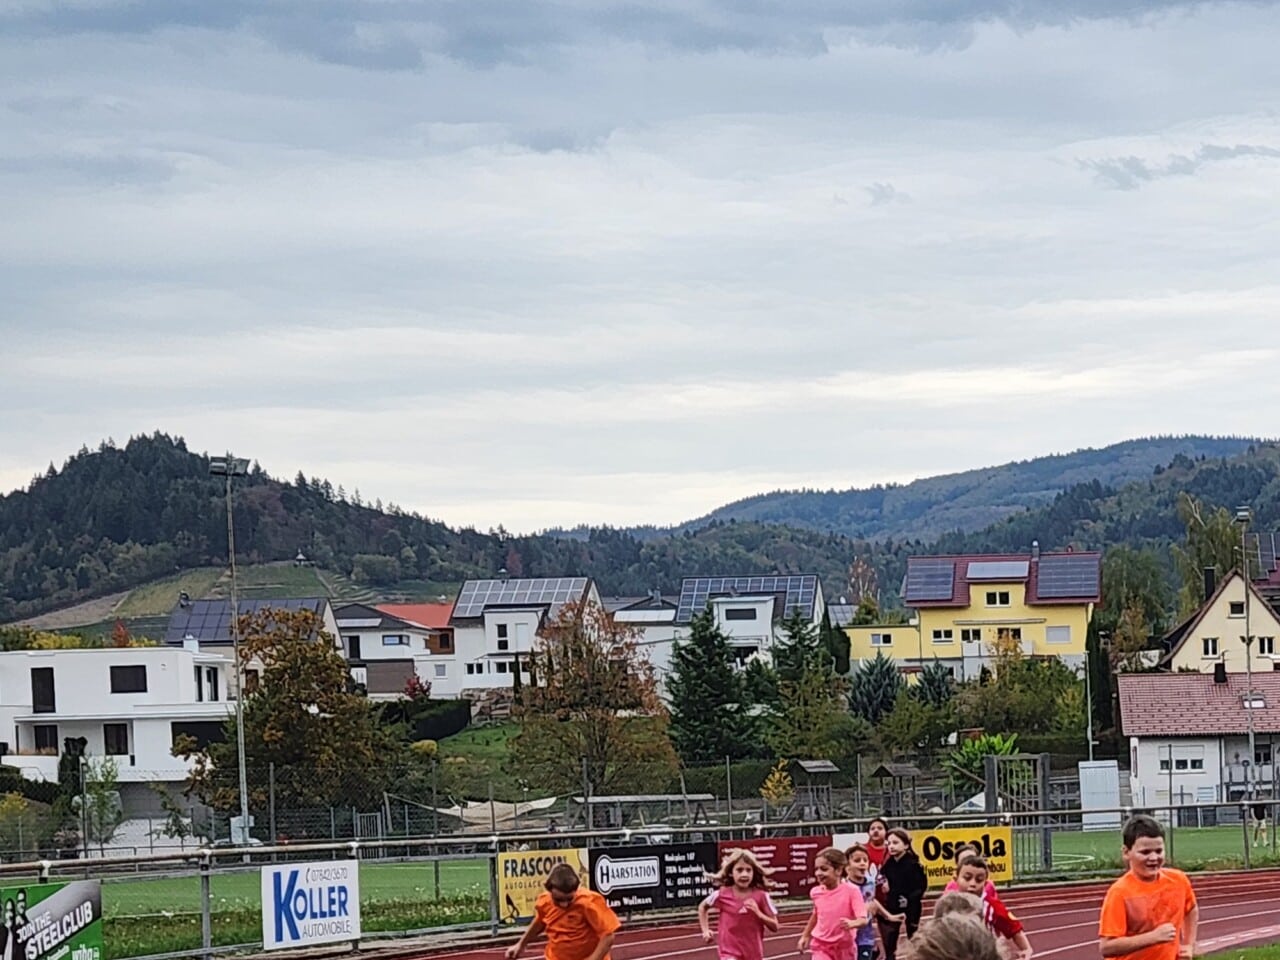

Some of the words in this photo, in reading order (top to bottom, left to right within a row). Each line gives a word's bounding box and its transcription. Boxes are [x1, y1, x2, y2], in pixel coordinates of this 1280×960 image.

[923, 834, 1006, 861] Osola
[600, 865, 656, 884] HAARSTATION
[273, 870, 349, 942] KOLLER
[16, 920, 35, 943] JOIN
[35, 911, 52, 931] THE
[25, 901, 93, 960] STEELCLUB
